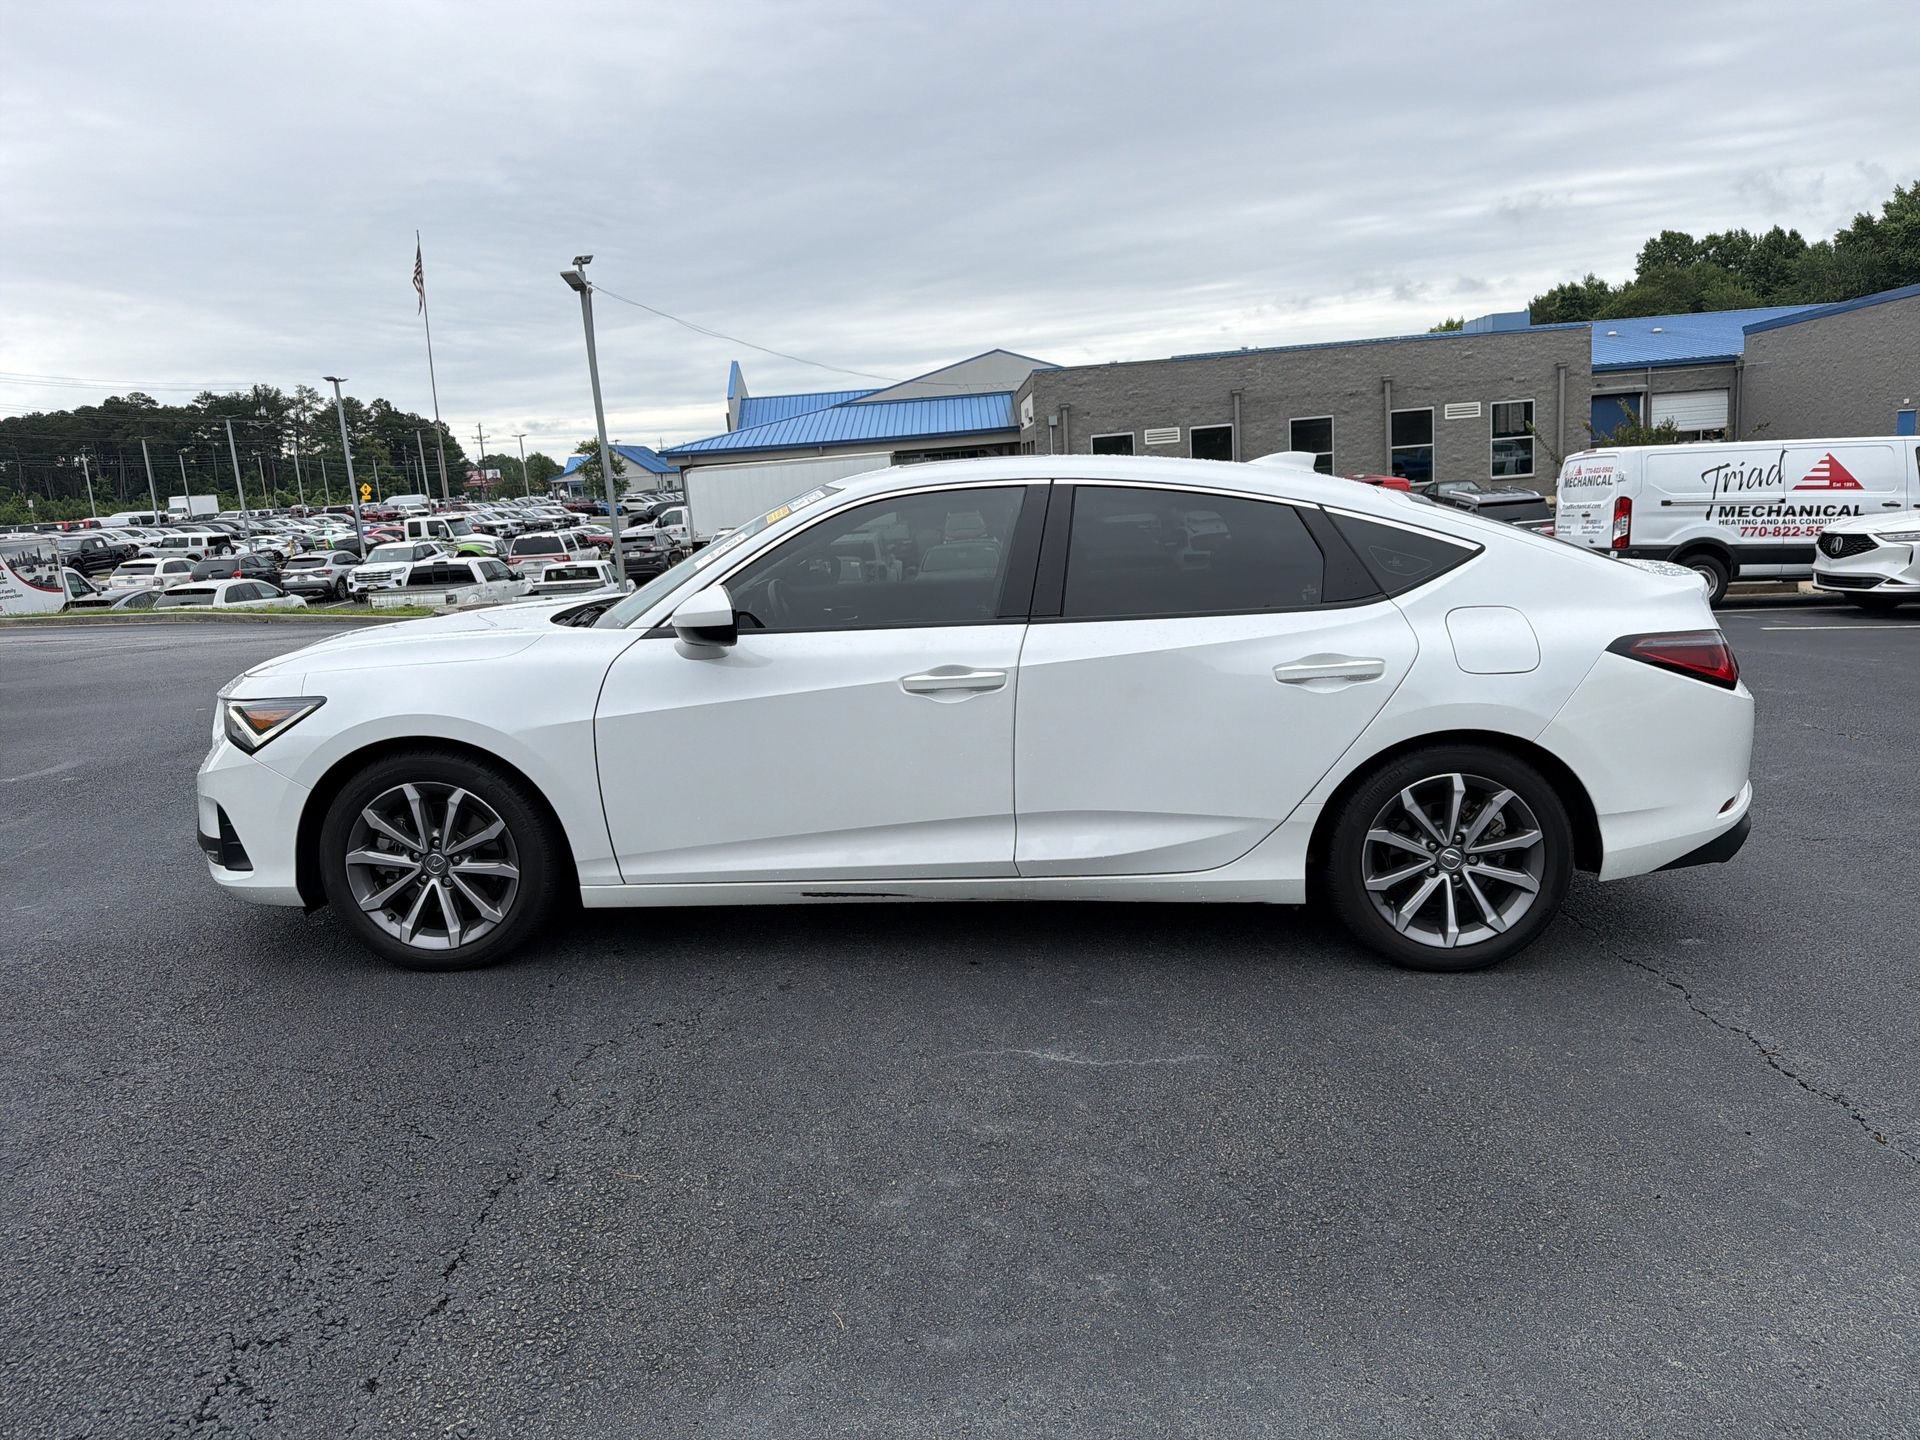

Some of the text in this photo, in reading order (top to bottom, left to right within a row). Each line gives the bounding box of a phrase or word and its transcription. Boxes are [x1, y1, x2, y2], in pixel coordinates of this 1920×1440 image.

[1564, 474, 1613, 488] MECHANICAL
[1701, 449, 1789, 520] Triad
[1718, 505, 1865, 518] MECHANICAL
